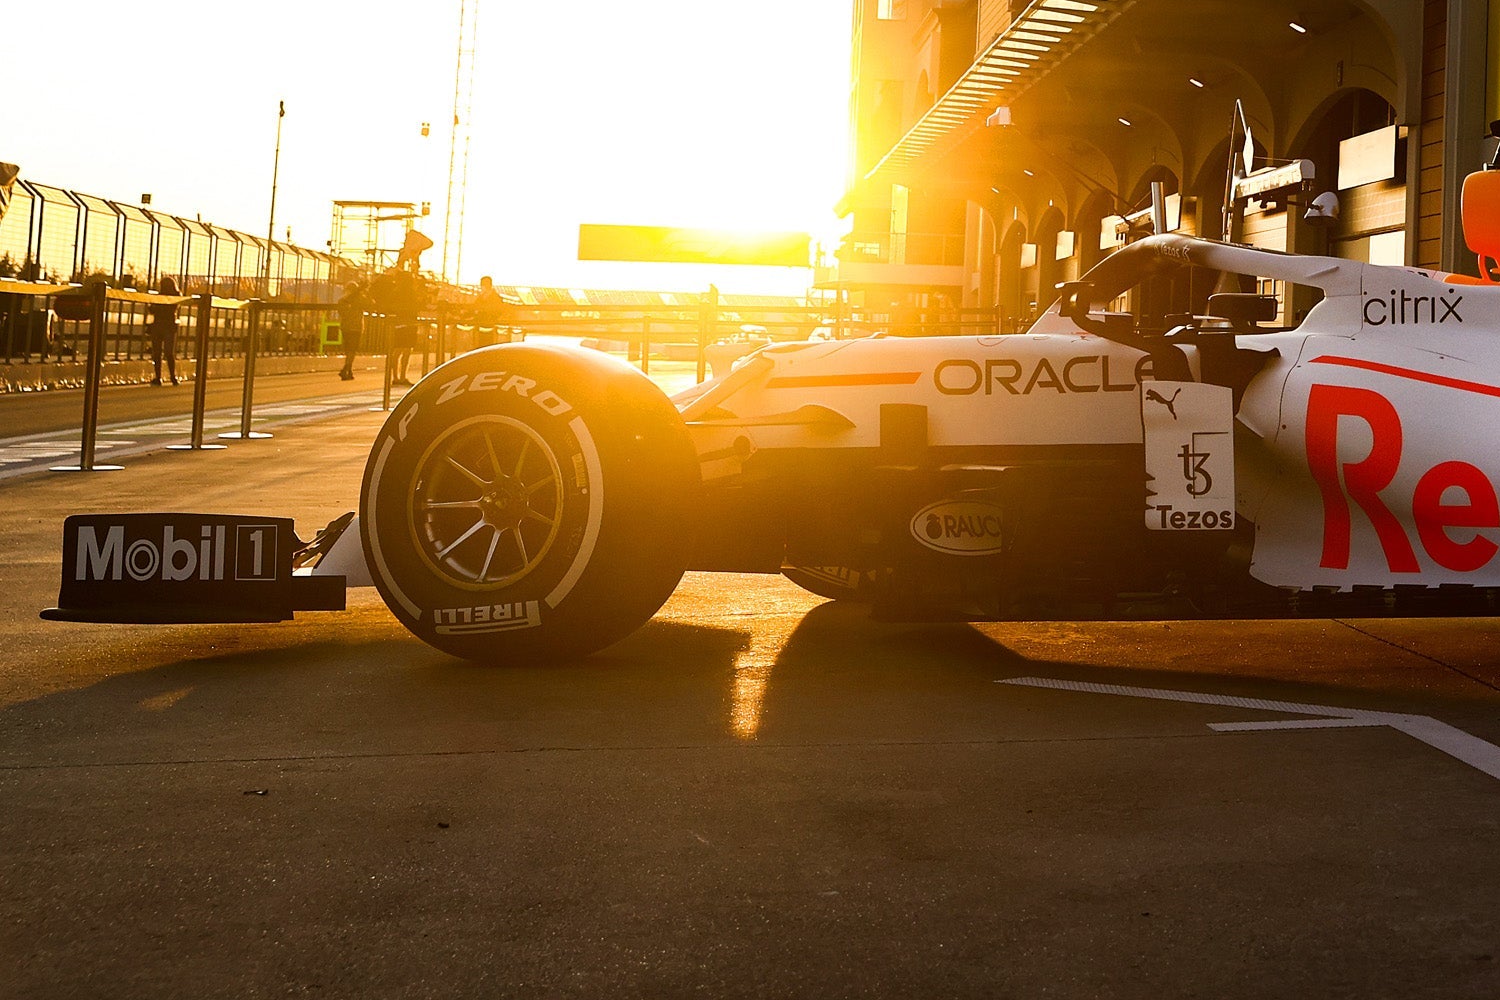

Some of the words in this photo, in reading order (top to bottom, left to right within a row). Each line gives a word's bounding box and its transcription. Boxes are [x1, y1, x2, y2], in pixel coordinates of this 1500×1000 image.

[1363, 286, 1463, 327] citrix
[395, 402, 419, 442] P
[435, 370, 574, 418] ZERO
[944, 515, 1000, 538] RAUC
[1156, 504, 1233, 530] Tezos
[75, 525, 224, 582] Mobil
[250, 529, 263, 576] 1
[434, 600, 541, 635] PIRELLI
